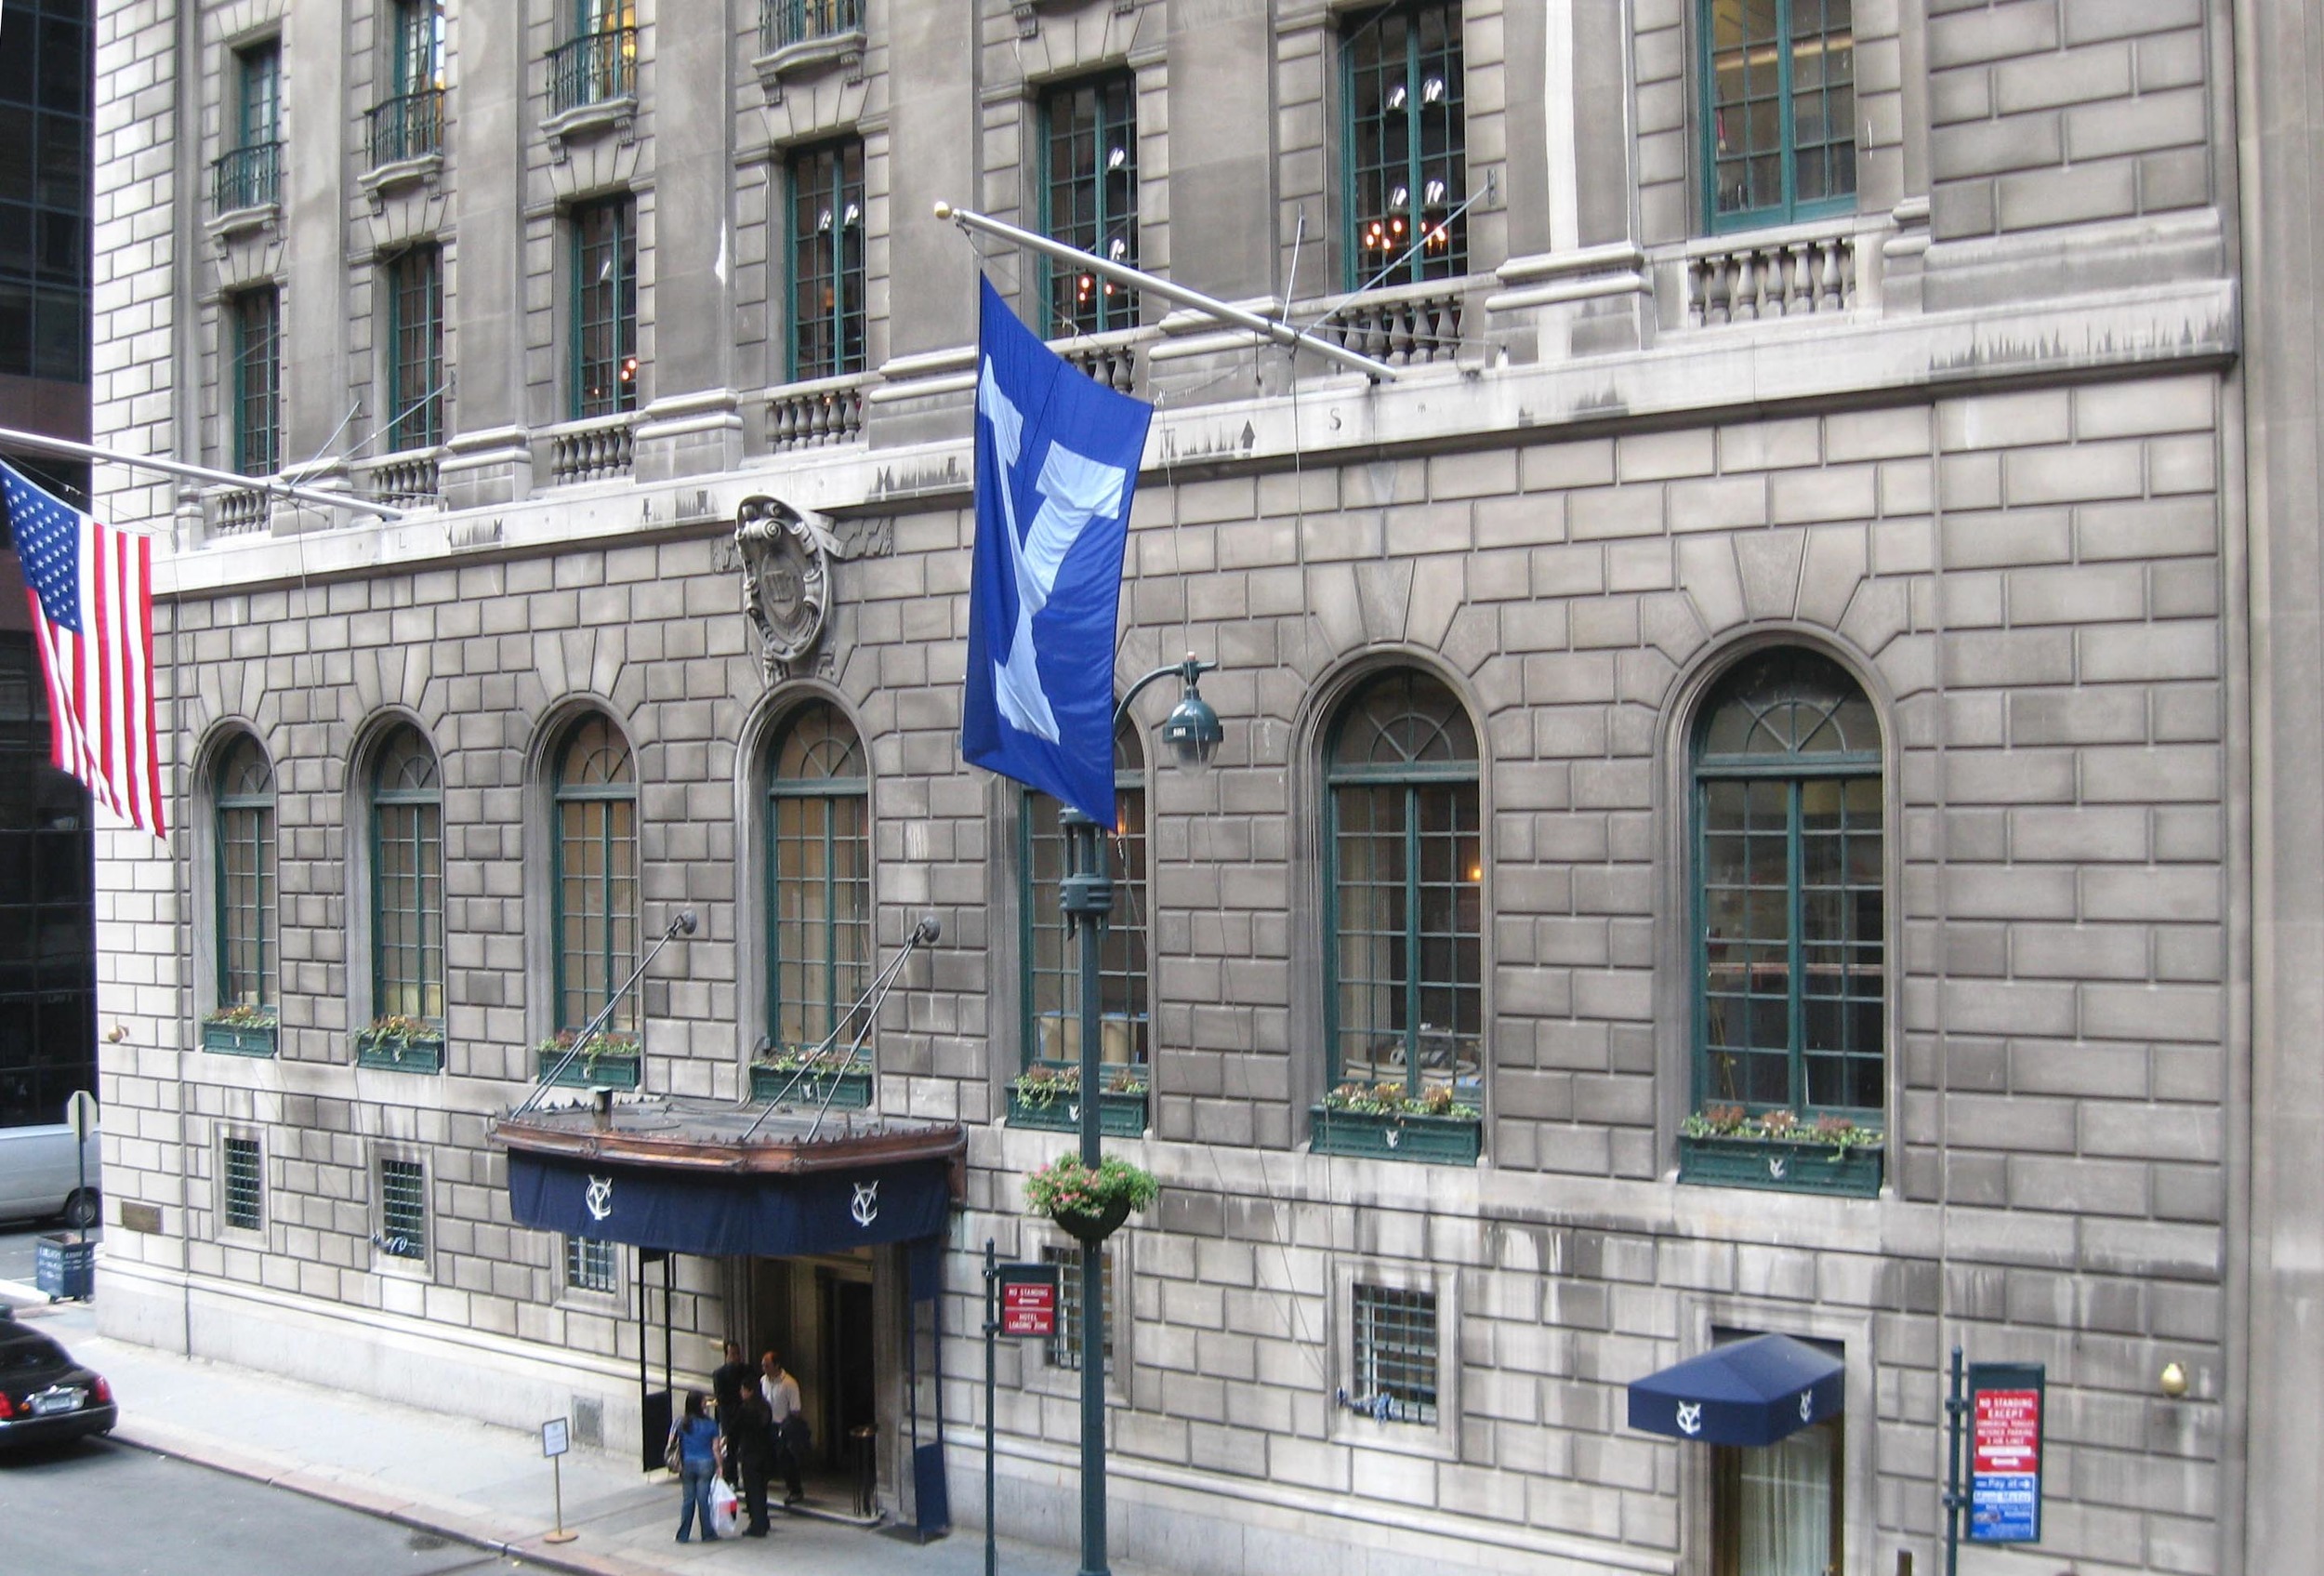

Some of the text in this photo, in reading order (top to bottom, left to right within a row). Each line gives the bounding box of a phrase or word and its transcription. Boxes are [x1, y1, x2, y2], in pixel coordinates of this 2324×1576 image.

[978, 353, 1126, 746] Y
[1021, 1288, 1049, 1297] STANDING
[1979, 1397, 2033, 1409] NO STANDING
[1987, 1409, 2024, 1419] EXCEPT
